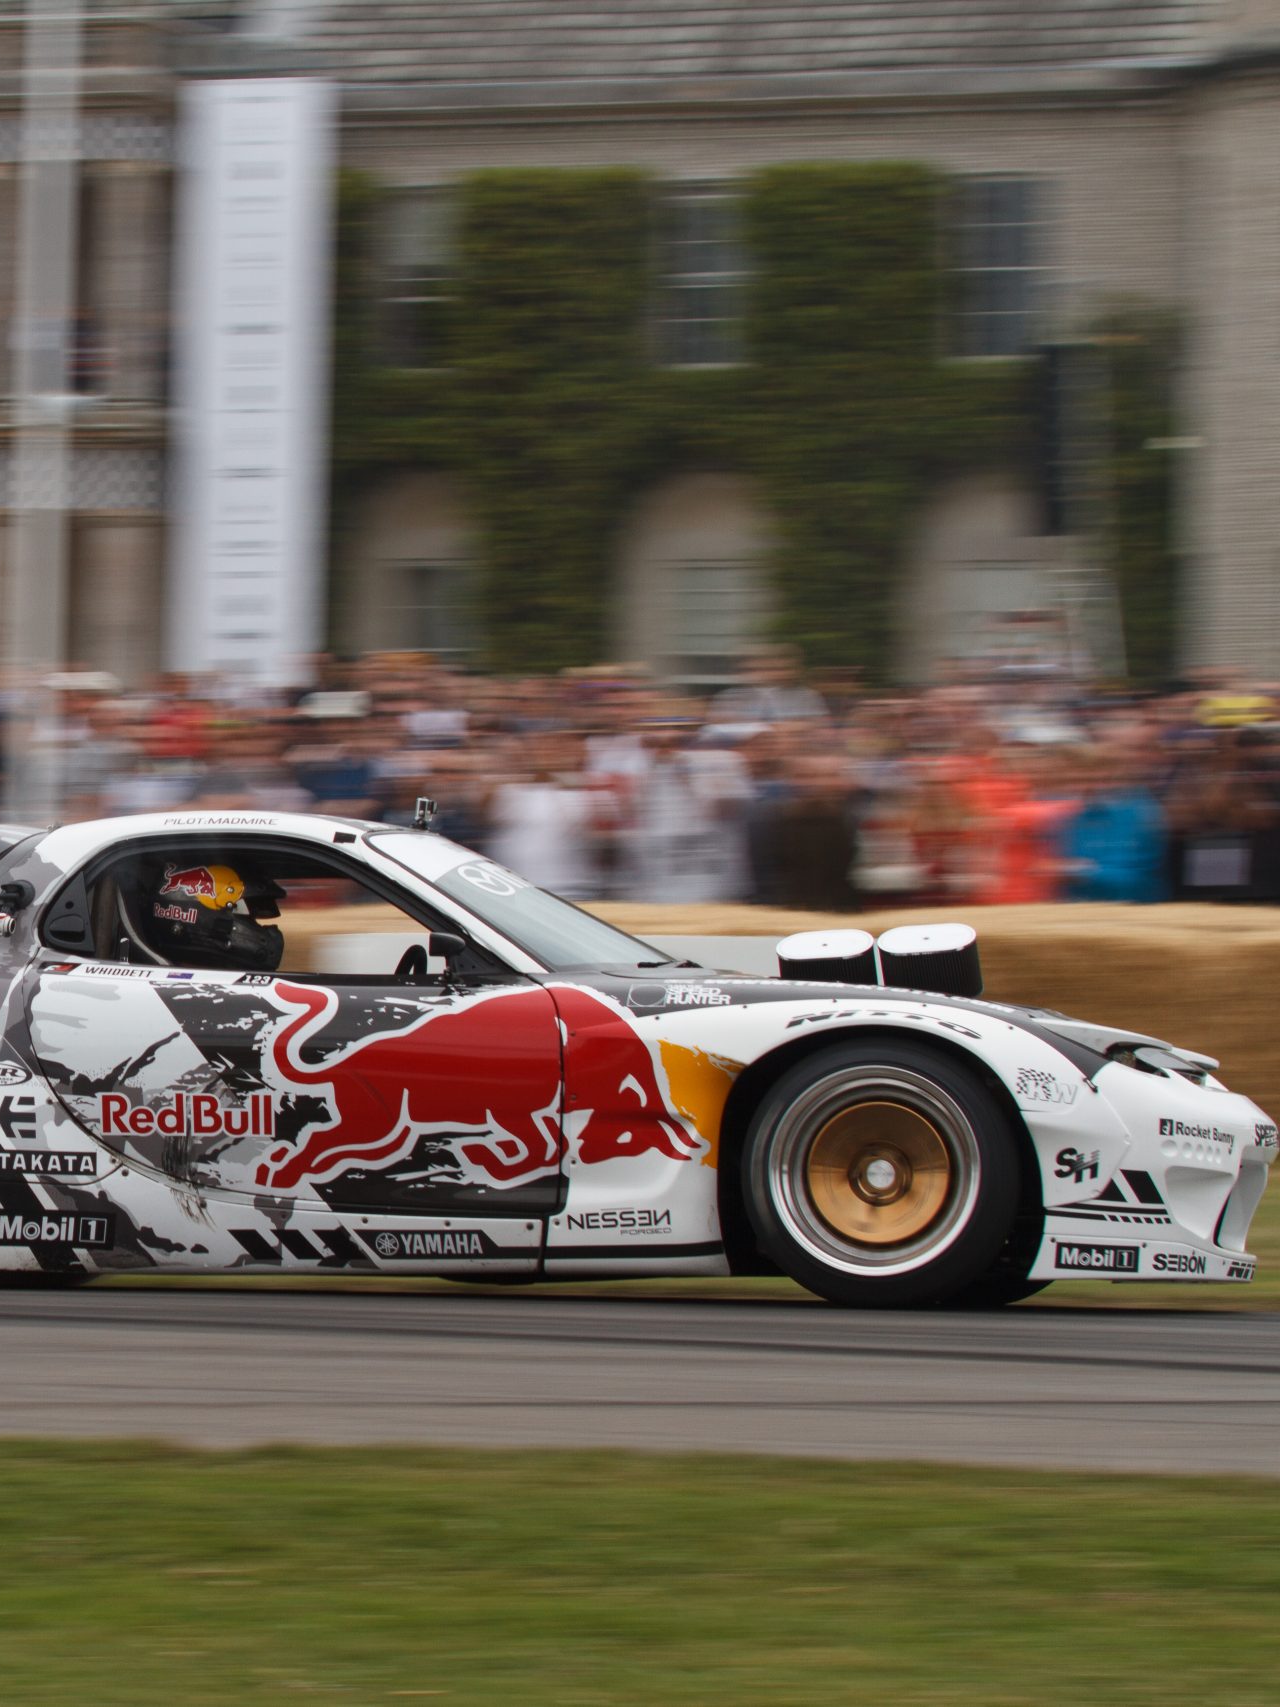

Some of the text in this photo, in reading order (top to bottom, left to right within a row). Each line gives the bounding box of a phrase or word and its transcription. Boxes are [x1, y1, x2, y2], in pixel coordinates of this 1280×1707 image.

[154, 903, 197, 924] Red Bull
[86, 966, 153, 978] WHIDDETT
[242, 974, 270, 984] 123
[666, 993, 731, 1005] HUNTER
[100, 1093, 274, 1137] Red Bull
[1175, 1121, 1235, 1146] Rocket Bunny
[400, 1233, 484, 1255] YAMAHA
[1060, 1247, 1115, 1269] Mobil
